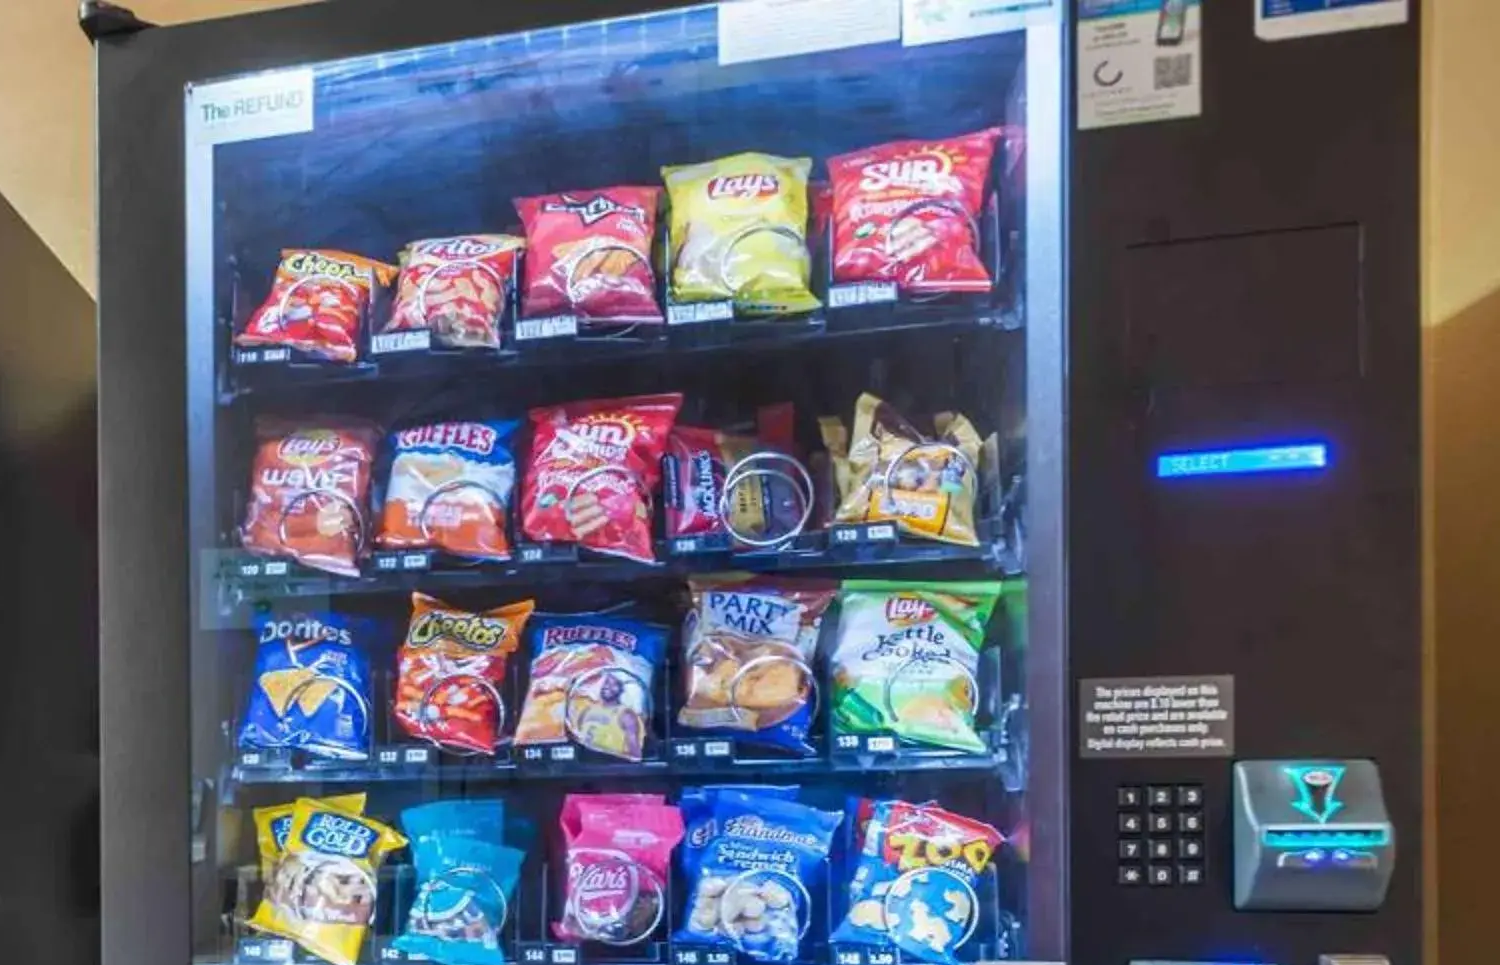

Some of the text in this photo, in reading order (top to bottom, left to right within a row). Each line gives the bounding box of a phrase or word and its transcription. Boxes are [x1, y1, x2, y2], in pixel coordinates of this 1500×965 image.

[200, 102, 230, 121] The
[411, 612, 505, 648] Cheetos
[724, 614, 774, 636] MIX
[260, 621, 352, 645] Doritos
[546, 626, 638, 651] RUFFLES
[875, 625, 946, 650] Kettle
[1127, 792, 1135, 804] 1
[1156, 791, 1167, 802] 2
[1187, 791, 1197, 803] 3
[317, 813, 372, 839] ROLD
[1125, 818, 1136, 829] 4
[1156, 817, 1167, 829] 5
[1187, 817, 1198, 829] 6
[306, 826, 370, 858] GOLD
[1127, 844, 1137, 856] 7
[1157, 843, 1167, 856] 8
[1187, 843, 1198, 855] 9
[1157, 870, 1167, 881] 0
